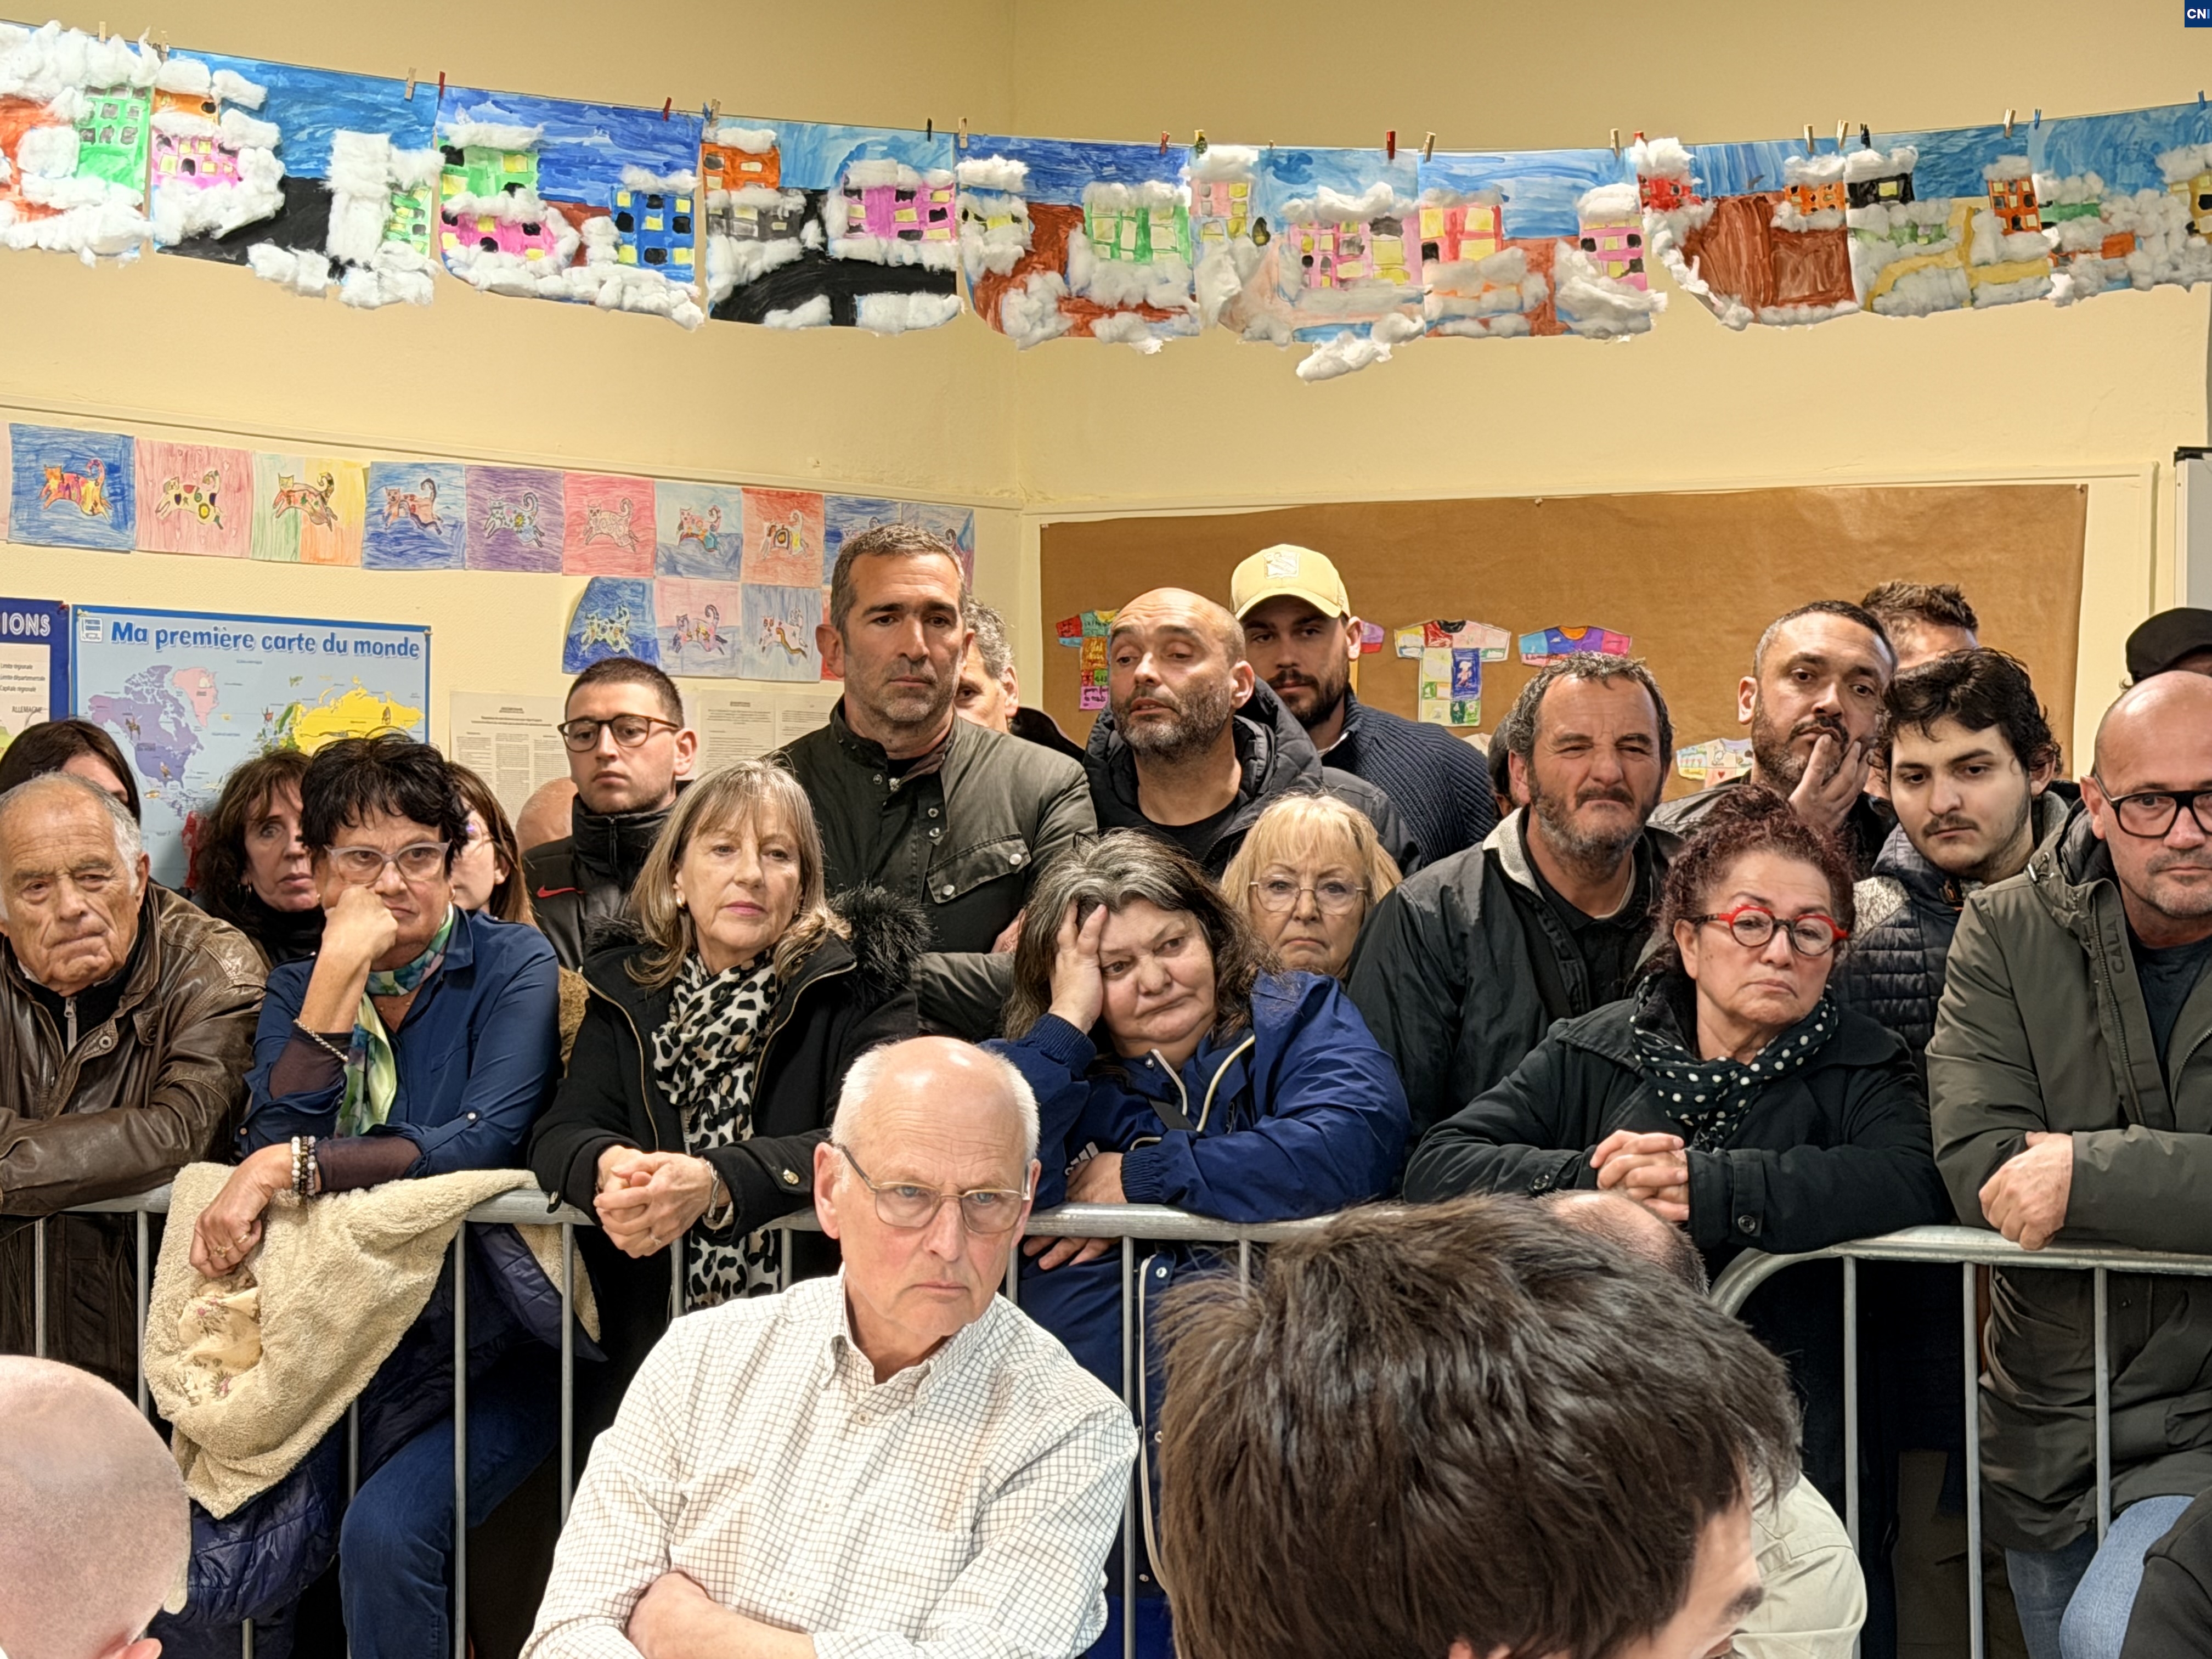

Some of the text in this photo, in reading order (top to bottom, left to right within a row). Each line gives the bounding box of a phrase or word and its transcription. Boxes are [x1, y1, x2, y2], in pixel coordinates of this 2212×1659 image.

[111, 621, 420, 658] Ma première carte du monde
